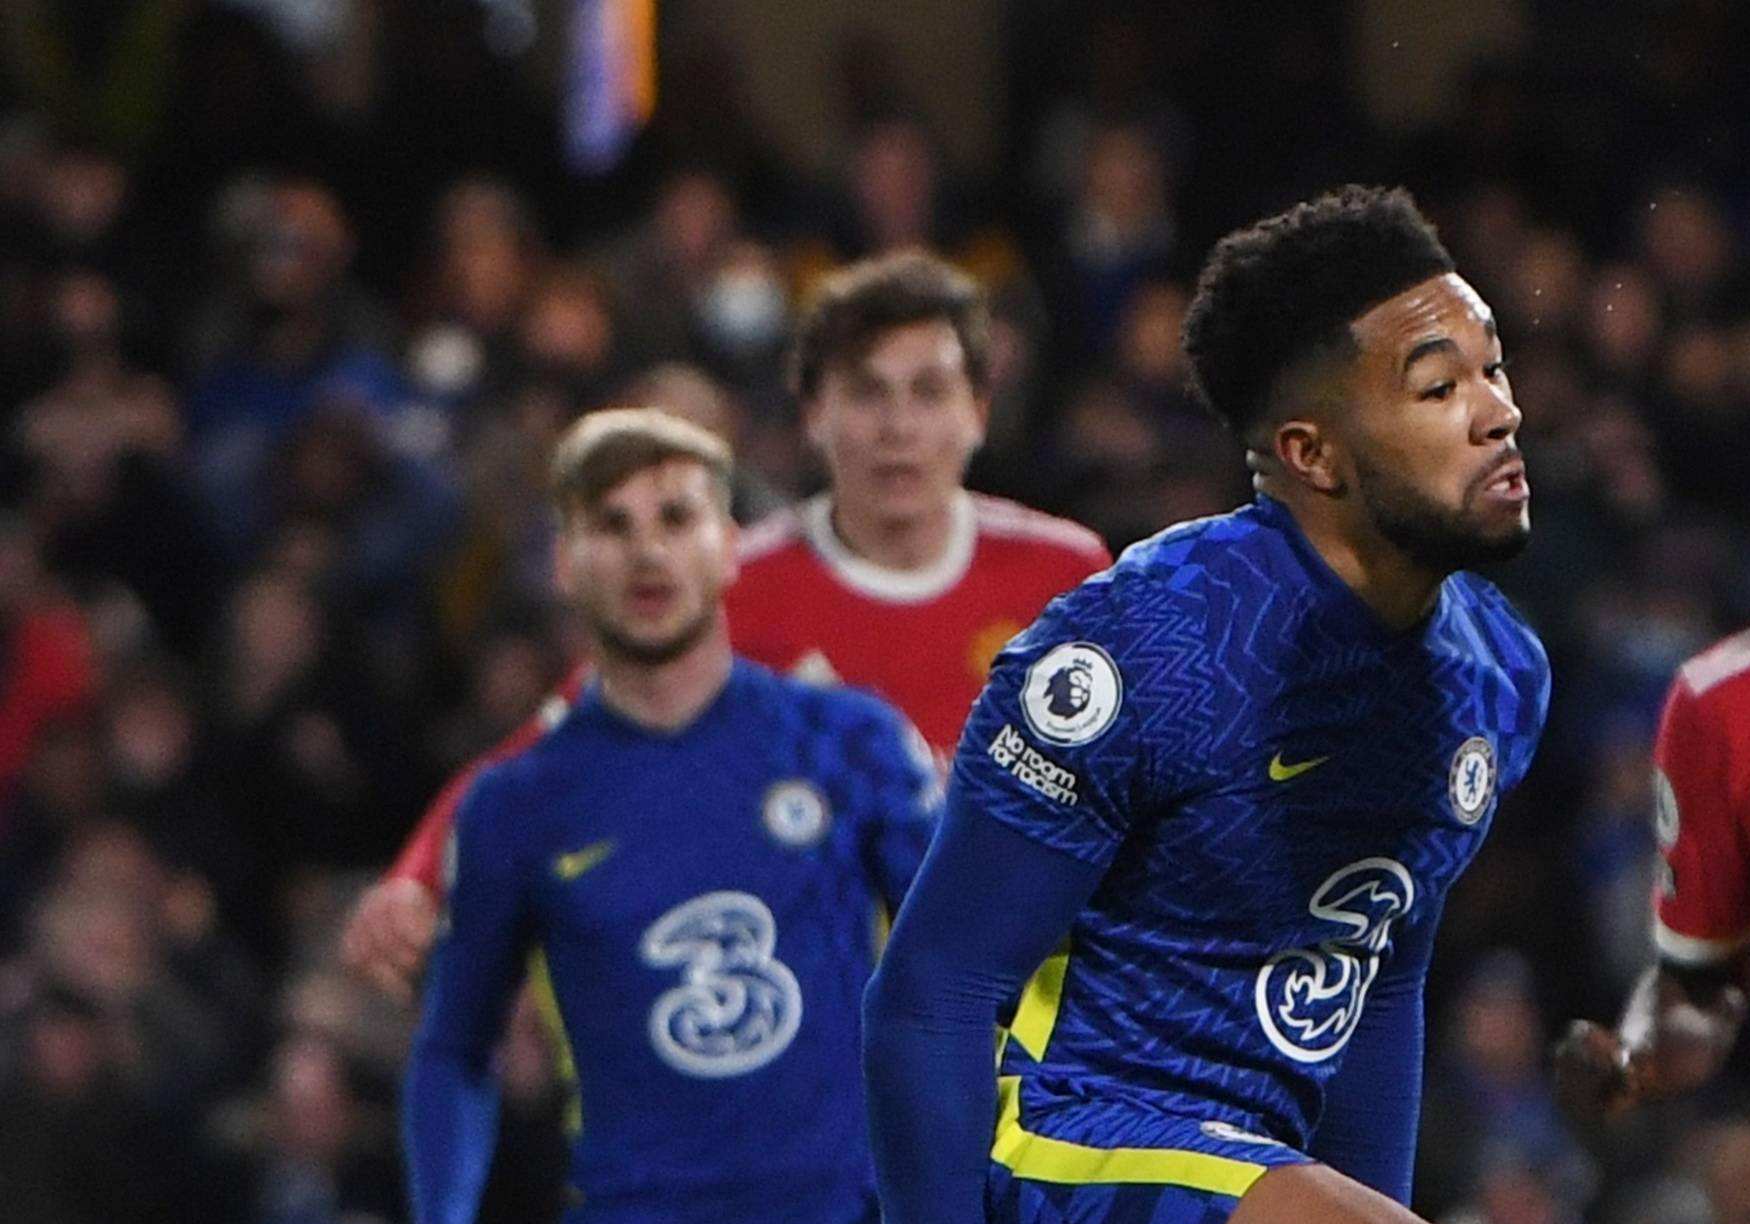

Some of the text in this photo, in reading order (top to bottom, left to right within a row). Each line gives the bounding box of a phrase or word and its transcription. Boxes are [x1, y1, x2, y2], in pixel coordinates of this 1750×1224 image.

[992, 723, 1077, 789] No room
[1011, 760, 1078, 806] racism
